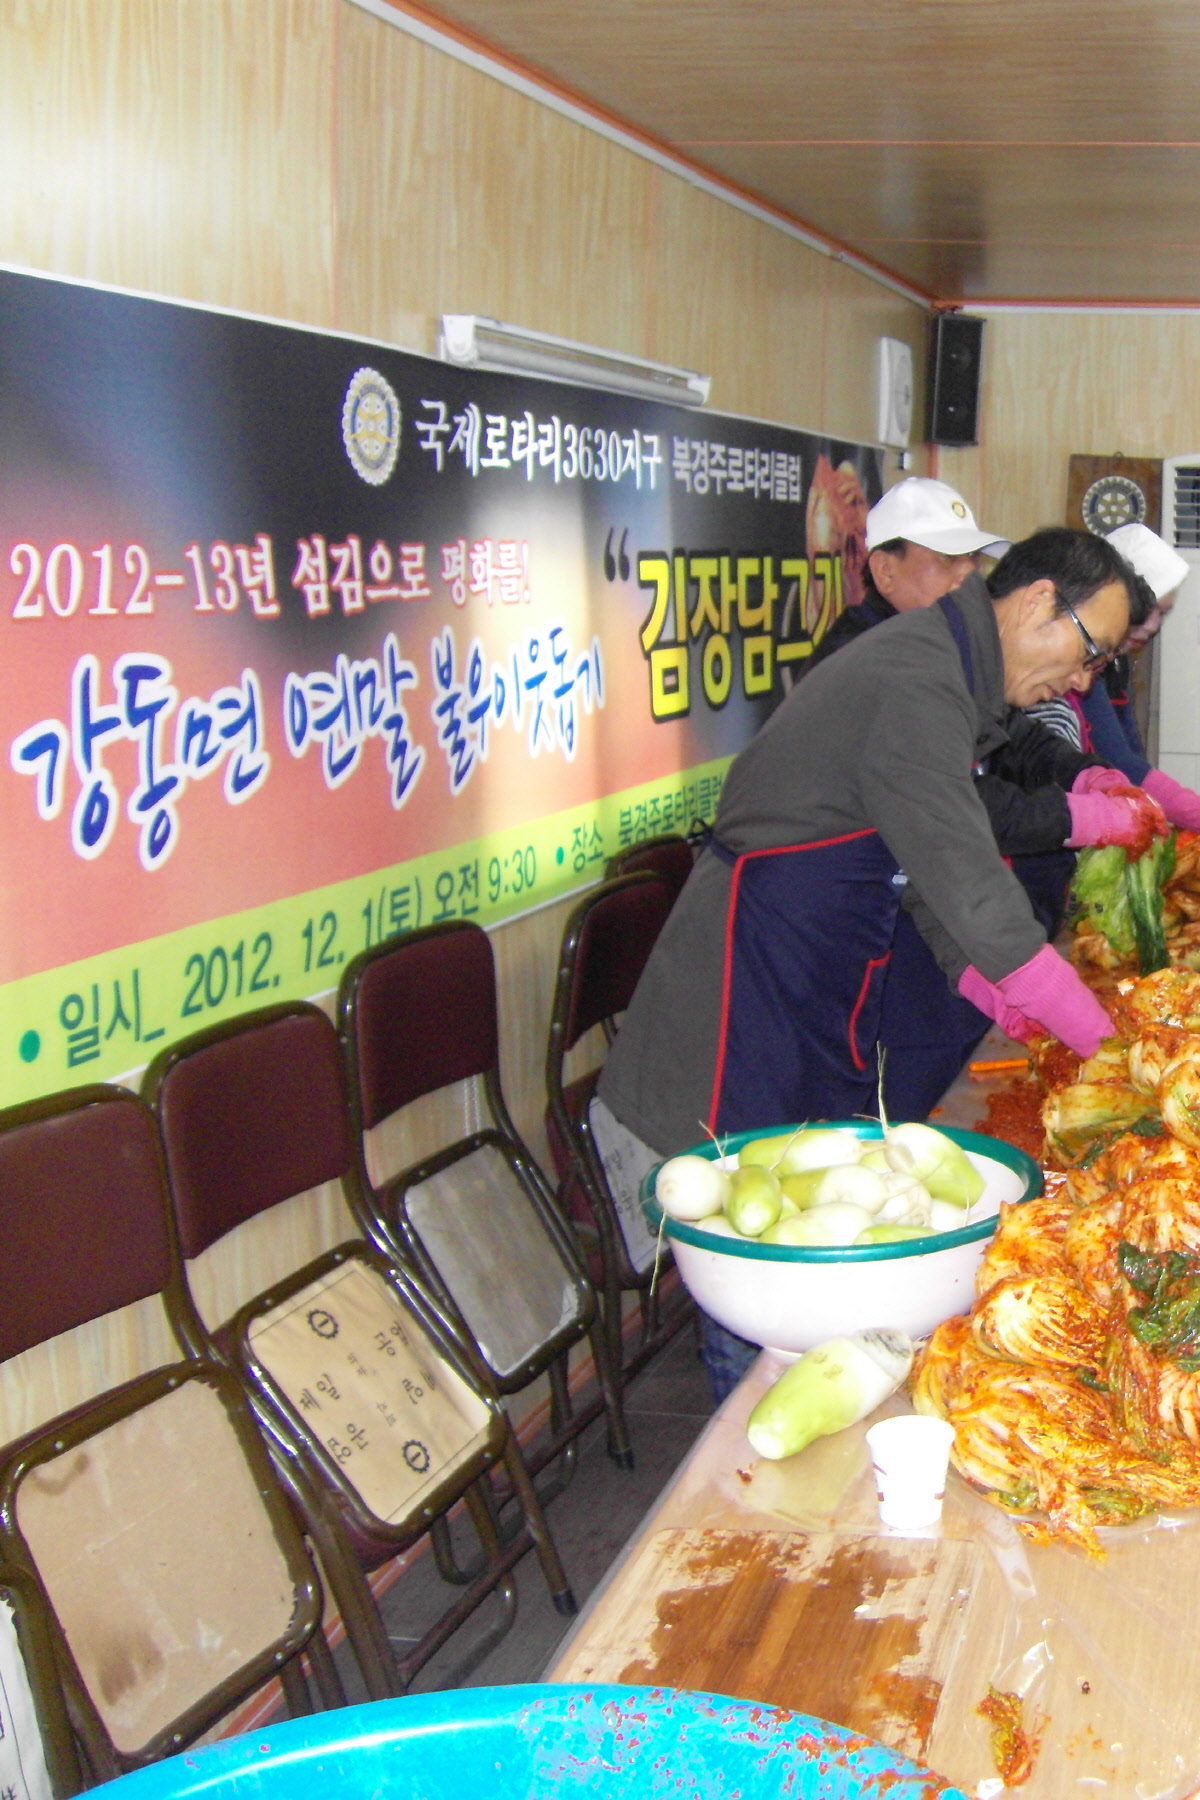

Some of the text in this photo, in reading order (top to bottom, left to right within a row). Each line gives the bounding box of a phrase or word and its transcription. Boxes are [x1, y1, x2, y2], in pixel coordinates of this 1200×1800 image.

[415, 399, 801, 503] 국제로타리3630지구 북경주로타리클럽
[11, 536, 531, 619] 2012-13년 섬김으로 평화를!
[14, 625, 603, 870] 강동면 연말 불우이웃돕기
[180, 931, 280, 1018] 2012.
[302, 911, 344, 973] 12.
[432, 859, 479, 921] 오전
[488, 846, 537, 903] 9:30
